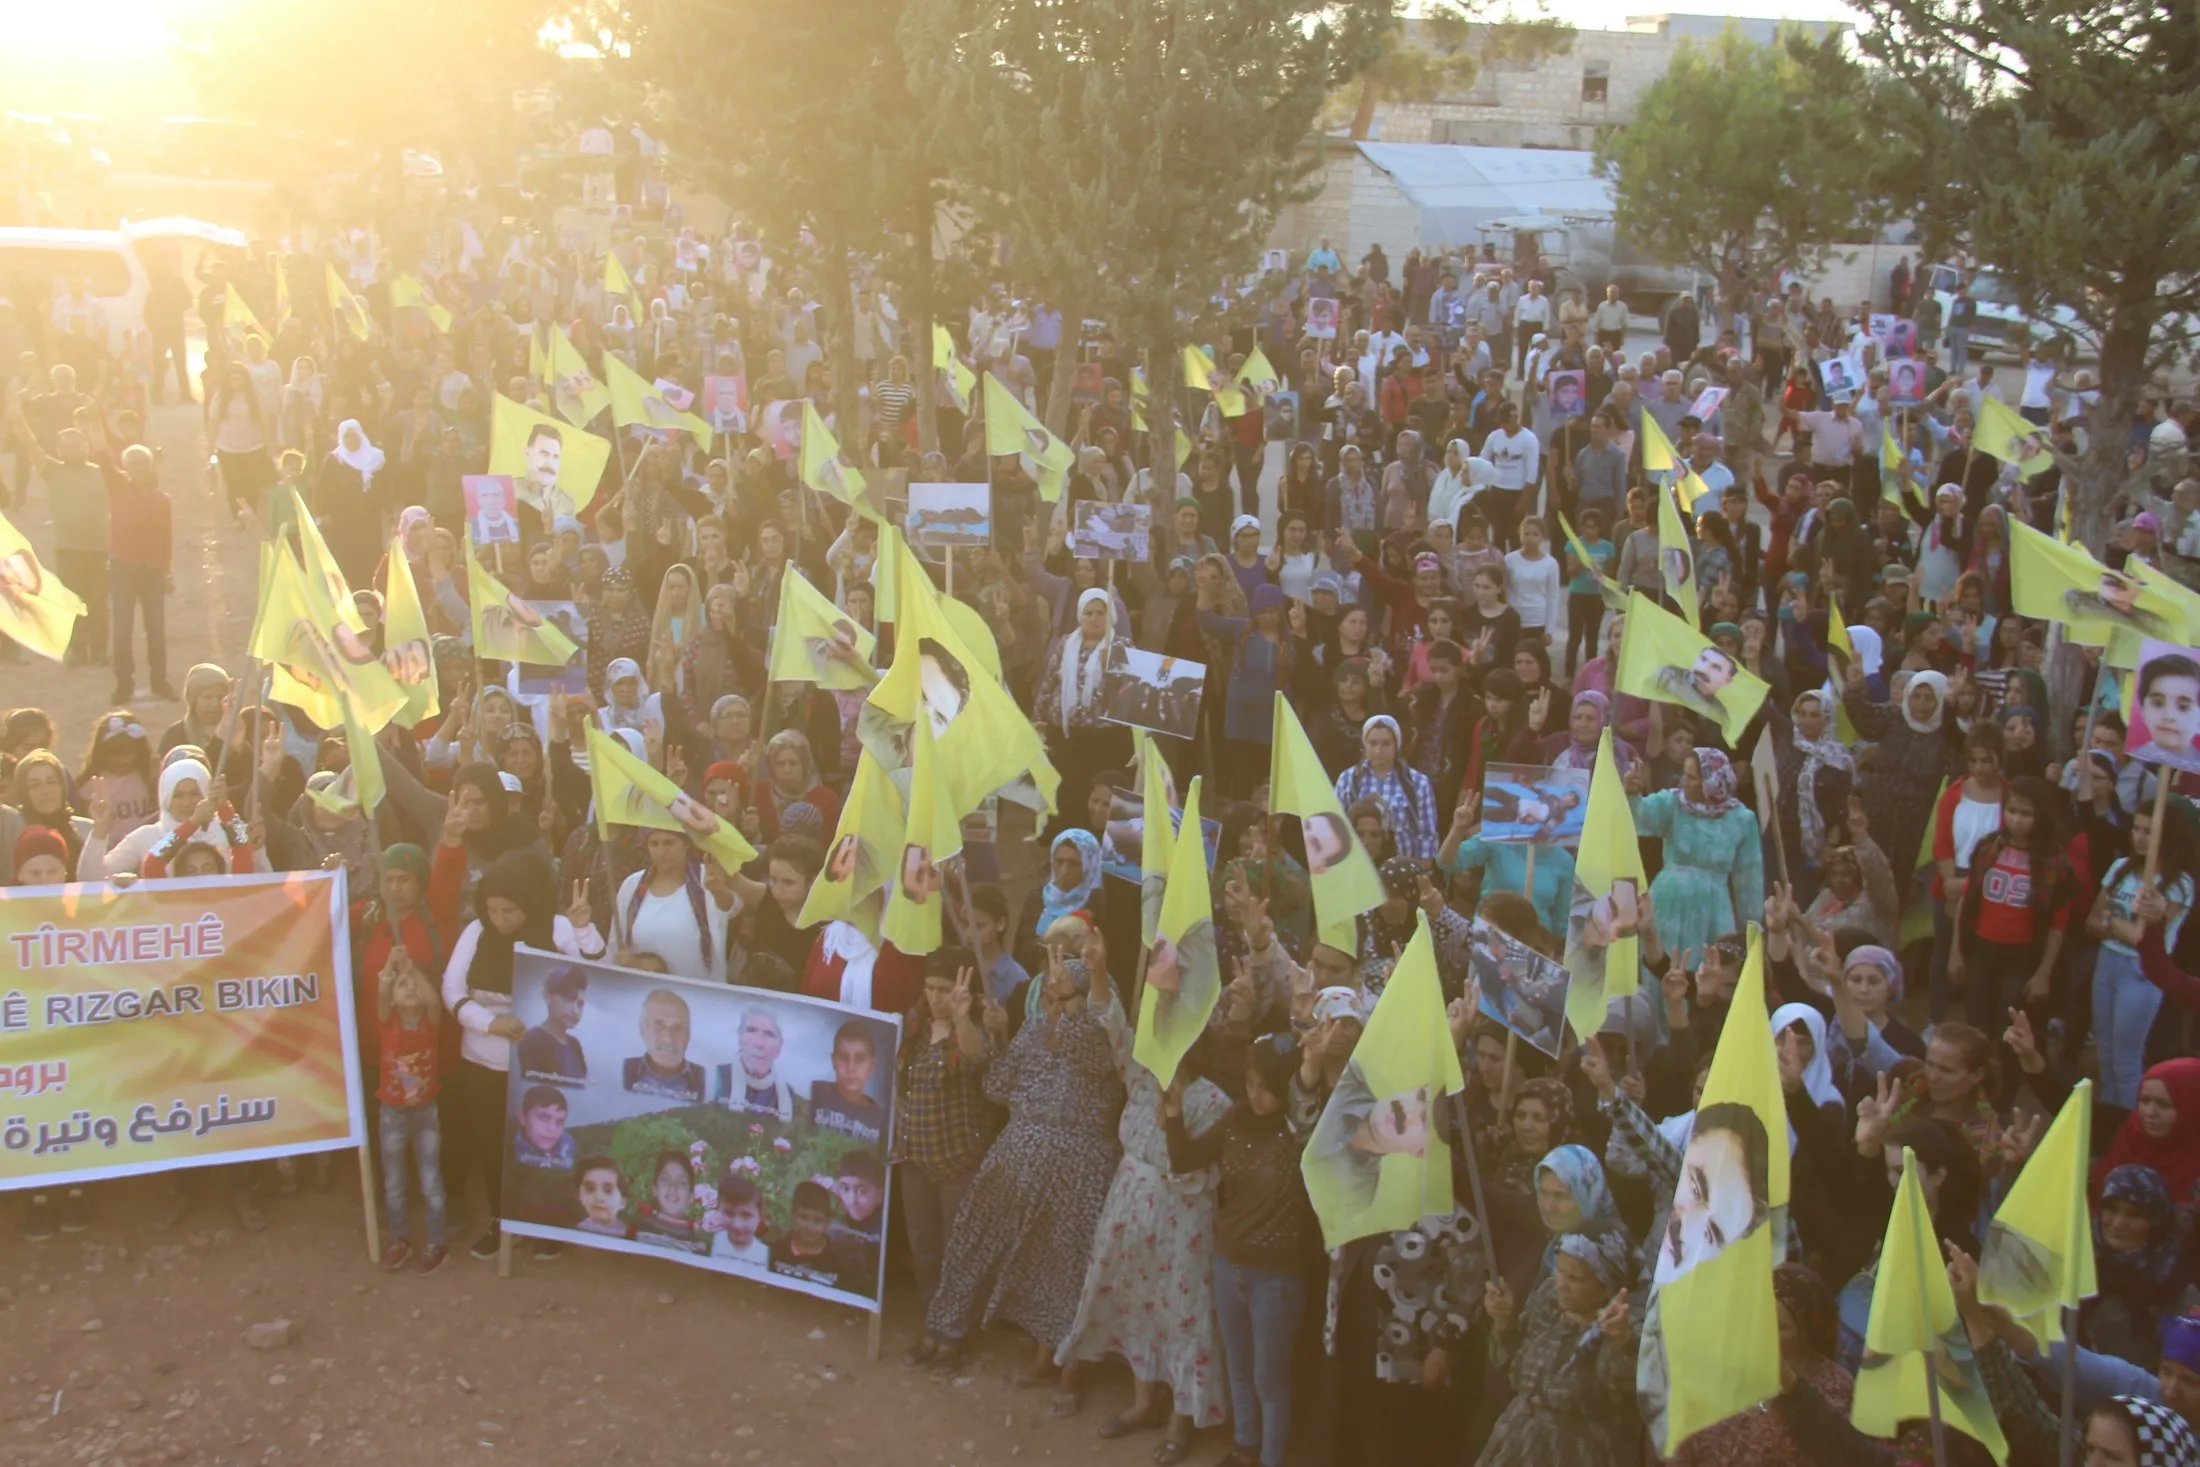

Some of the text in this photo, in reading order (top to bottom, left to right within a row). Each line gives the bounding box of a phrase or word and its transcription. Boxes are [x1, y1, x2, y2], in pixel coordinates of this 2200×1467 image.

[10, 913, 224, 968] TÎRMEHÊ
[46, 986, 203, 1026] RIZGAR
[216, 973, 318, 1010] BIKIN
[4, 1095, 276, 1155] سنرفع وتيرة
